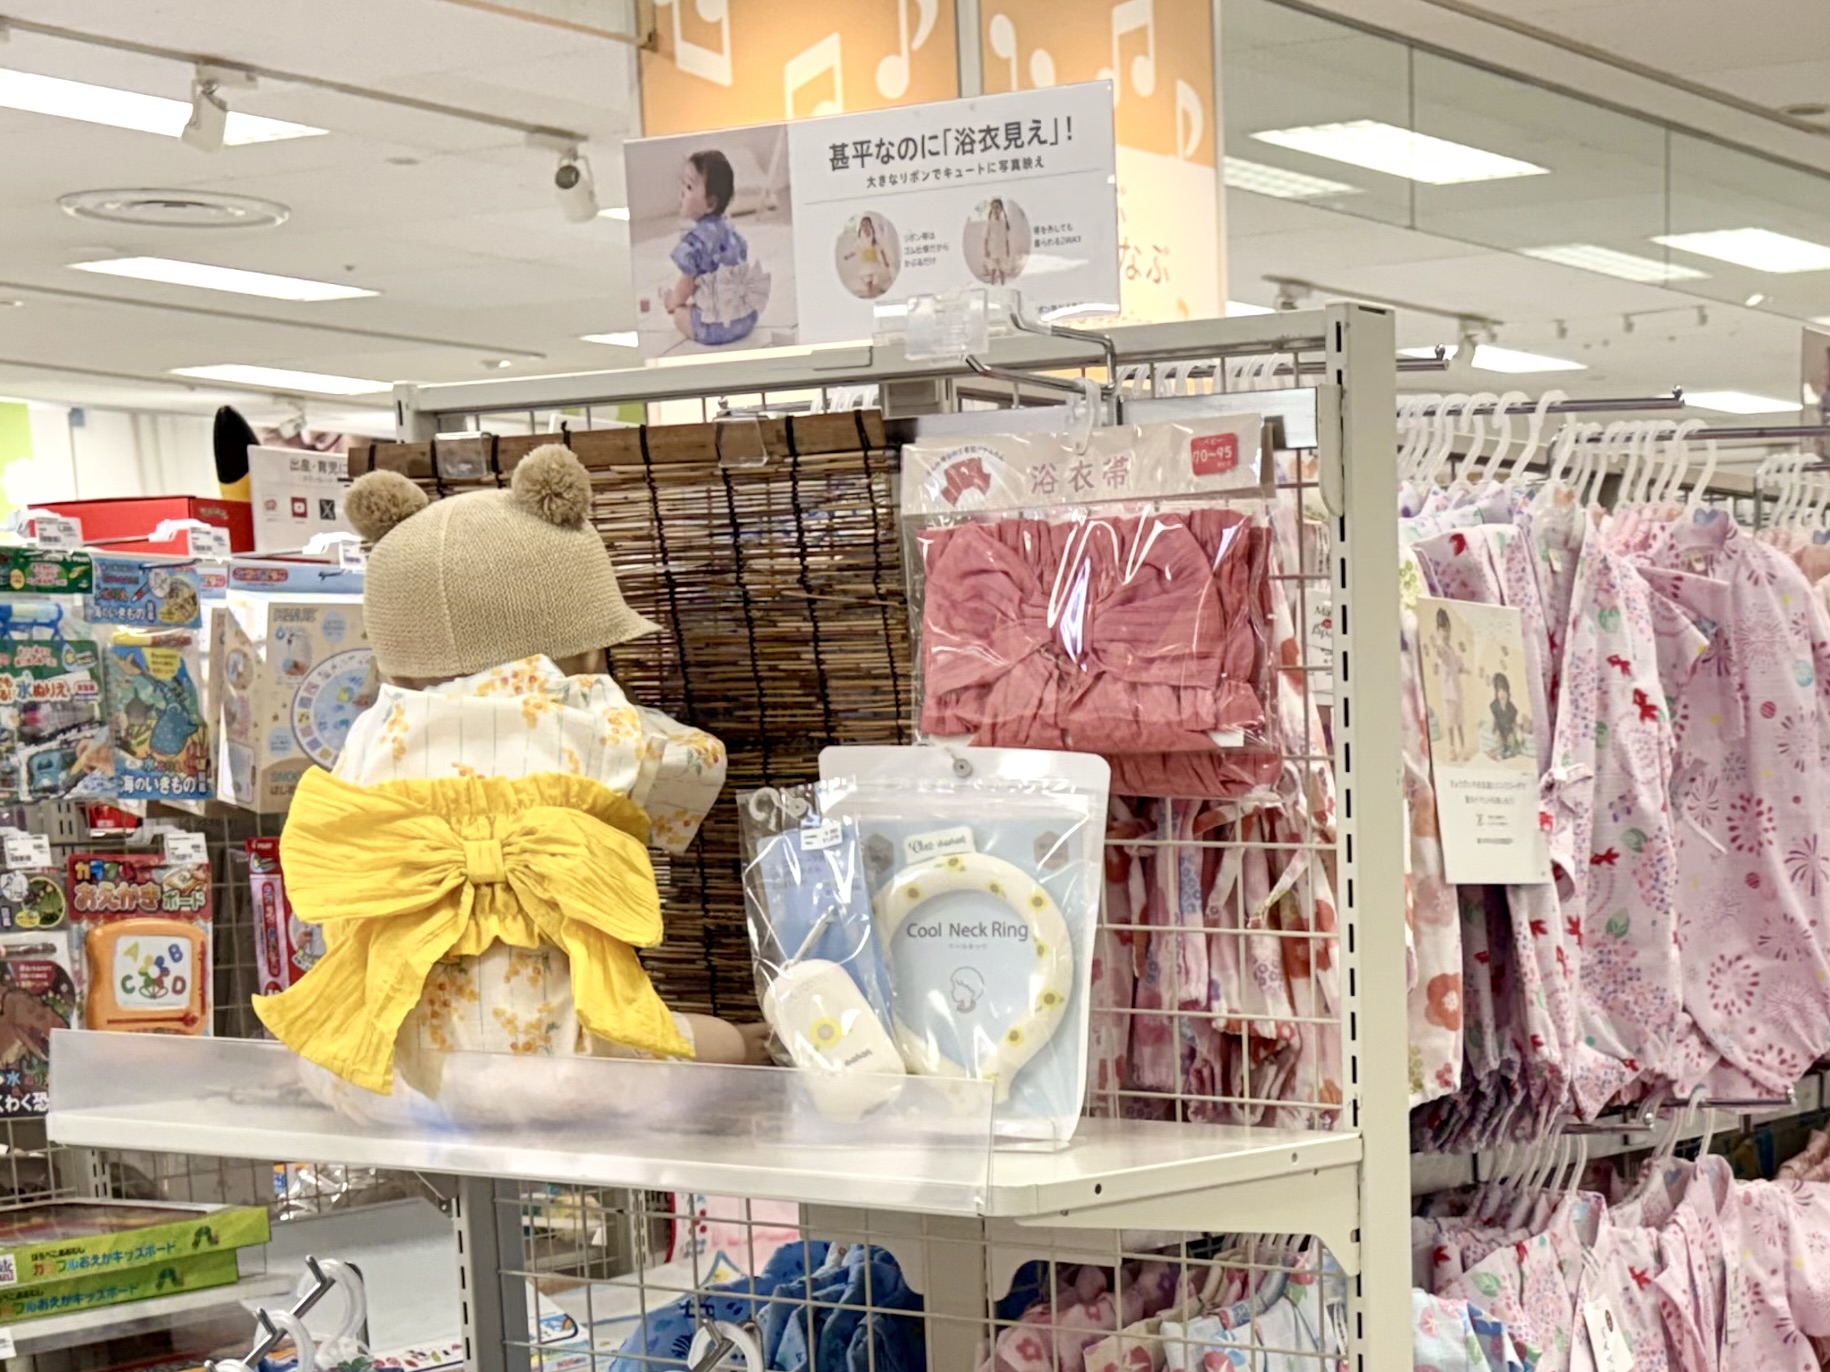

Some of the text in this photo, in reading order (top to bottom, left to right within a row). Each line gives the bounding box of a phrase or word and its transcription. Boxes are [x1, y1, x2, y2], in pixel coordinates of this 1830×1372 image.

[867, 155, 1045, 188] 大きなリボンでキュートに写真映え
[1030, 455, 1131, 495] 浴衣帯
[906, 920, 1029, 942] Cool Neck Ring
